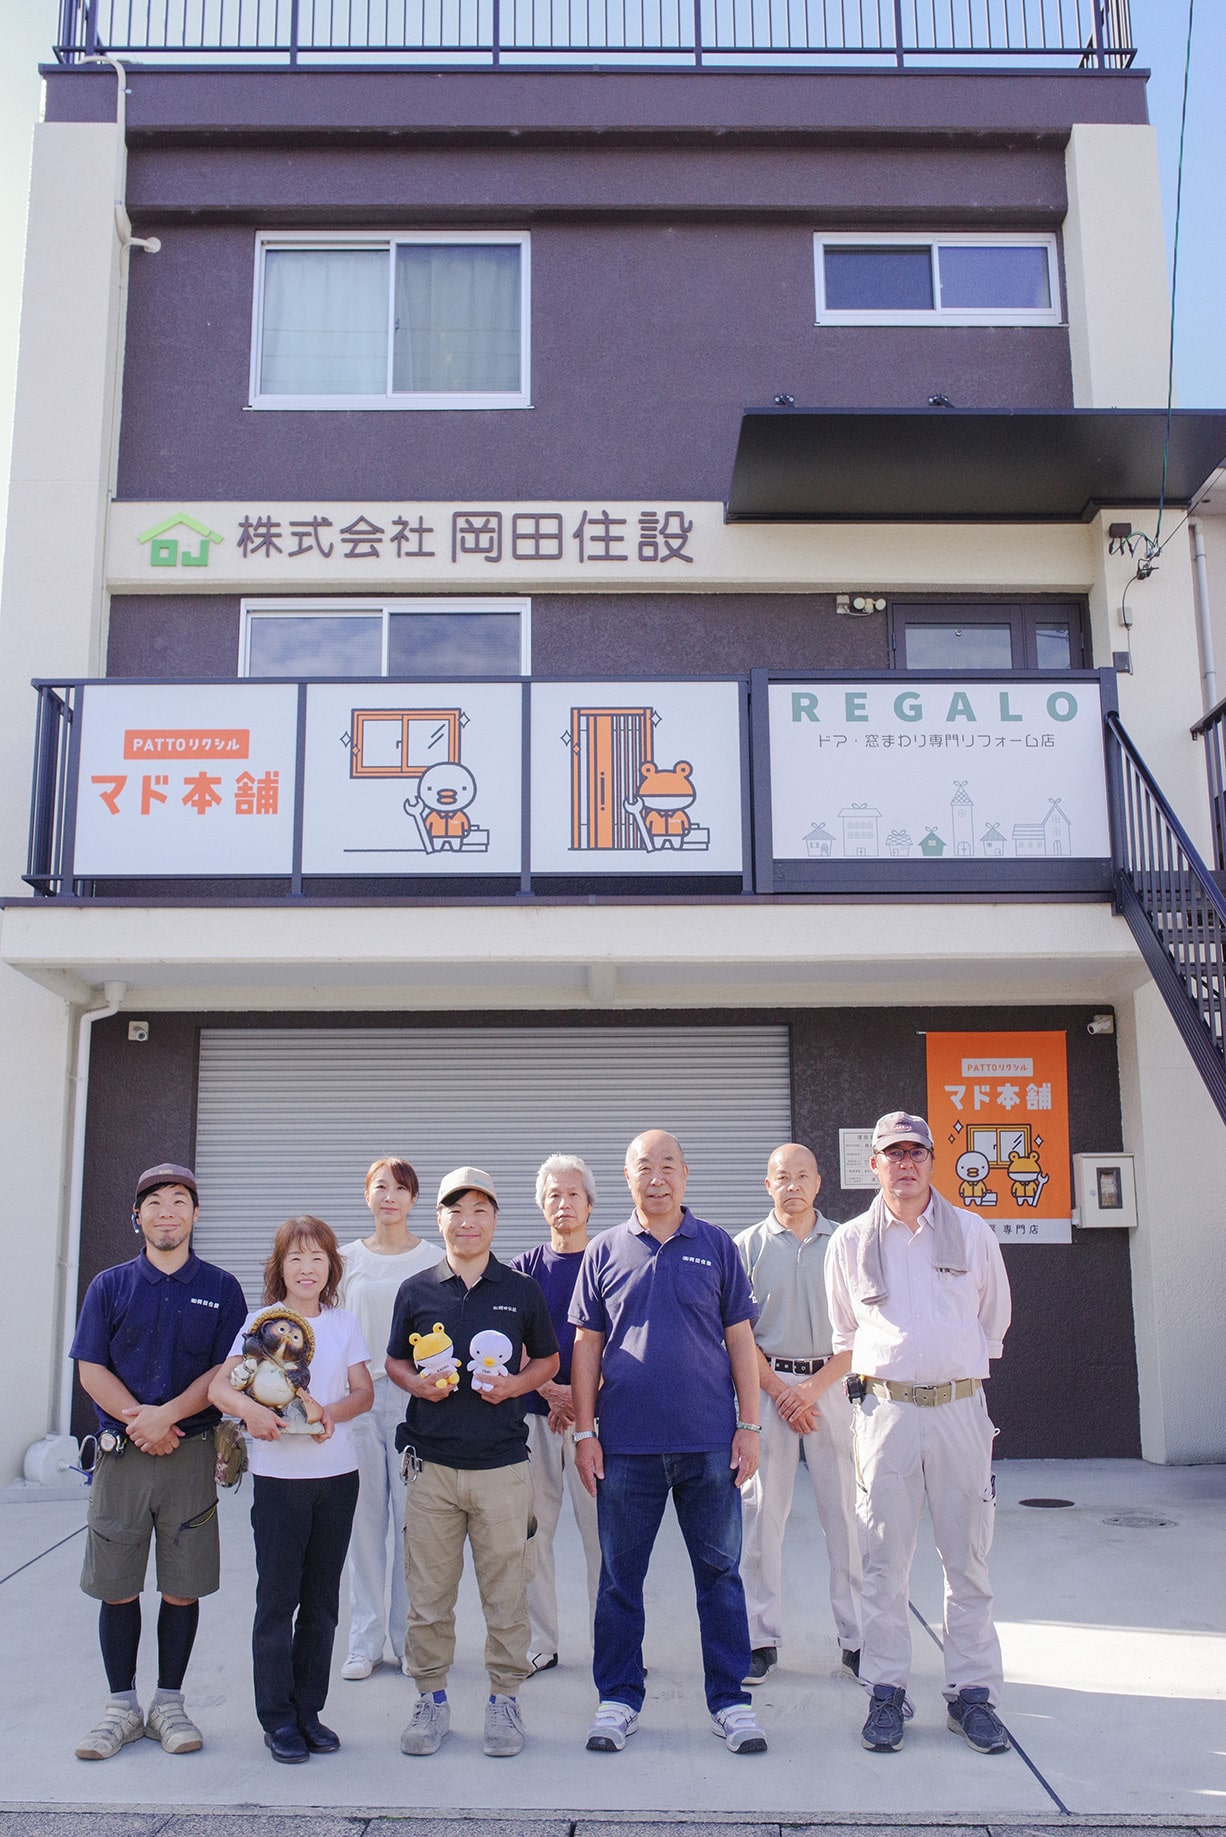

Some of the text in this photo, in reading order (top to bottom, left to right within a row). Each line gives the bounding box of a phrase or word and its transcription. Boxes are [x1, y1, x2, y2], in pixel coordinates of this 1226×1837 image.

[237, 510, 694, 563] 株式会社岡田住設
[791, 691, 1079, 723] REGALO
[132, 738, 240, 752] PATTOリクシル
[818, 733, 1056, 748] ドア・窓まわり専門リフォーム店
[90, 771, 279, 815] マド本舗
[943, 1082, 1052, 1111] マド本舗
